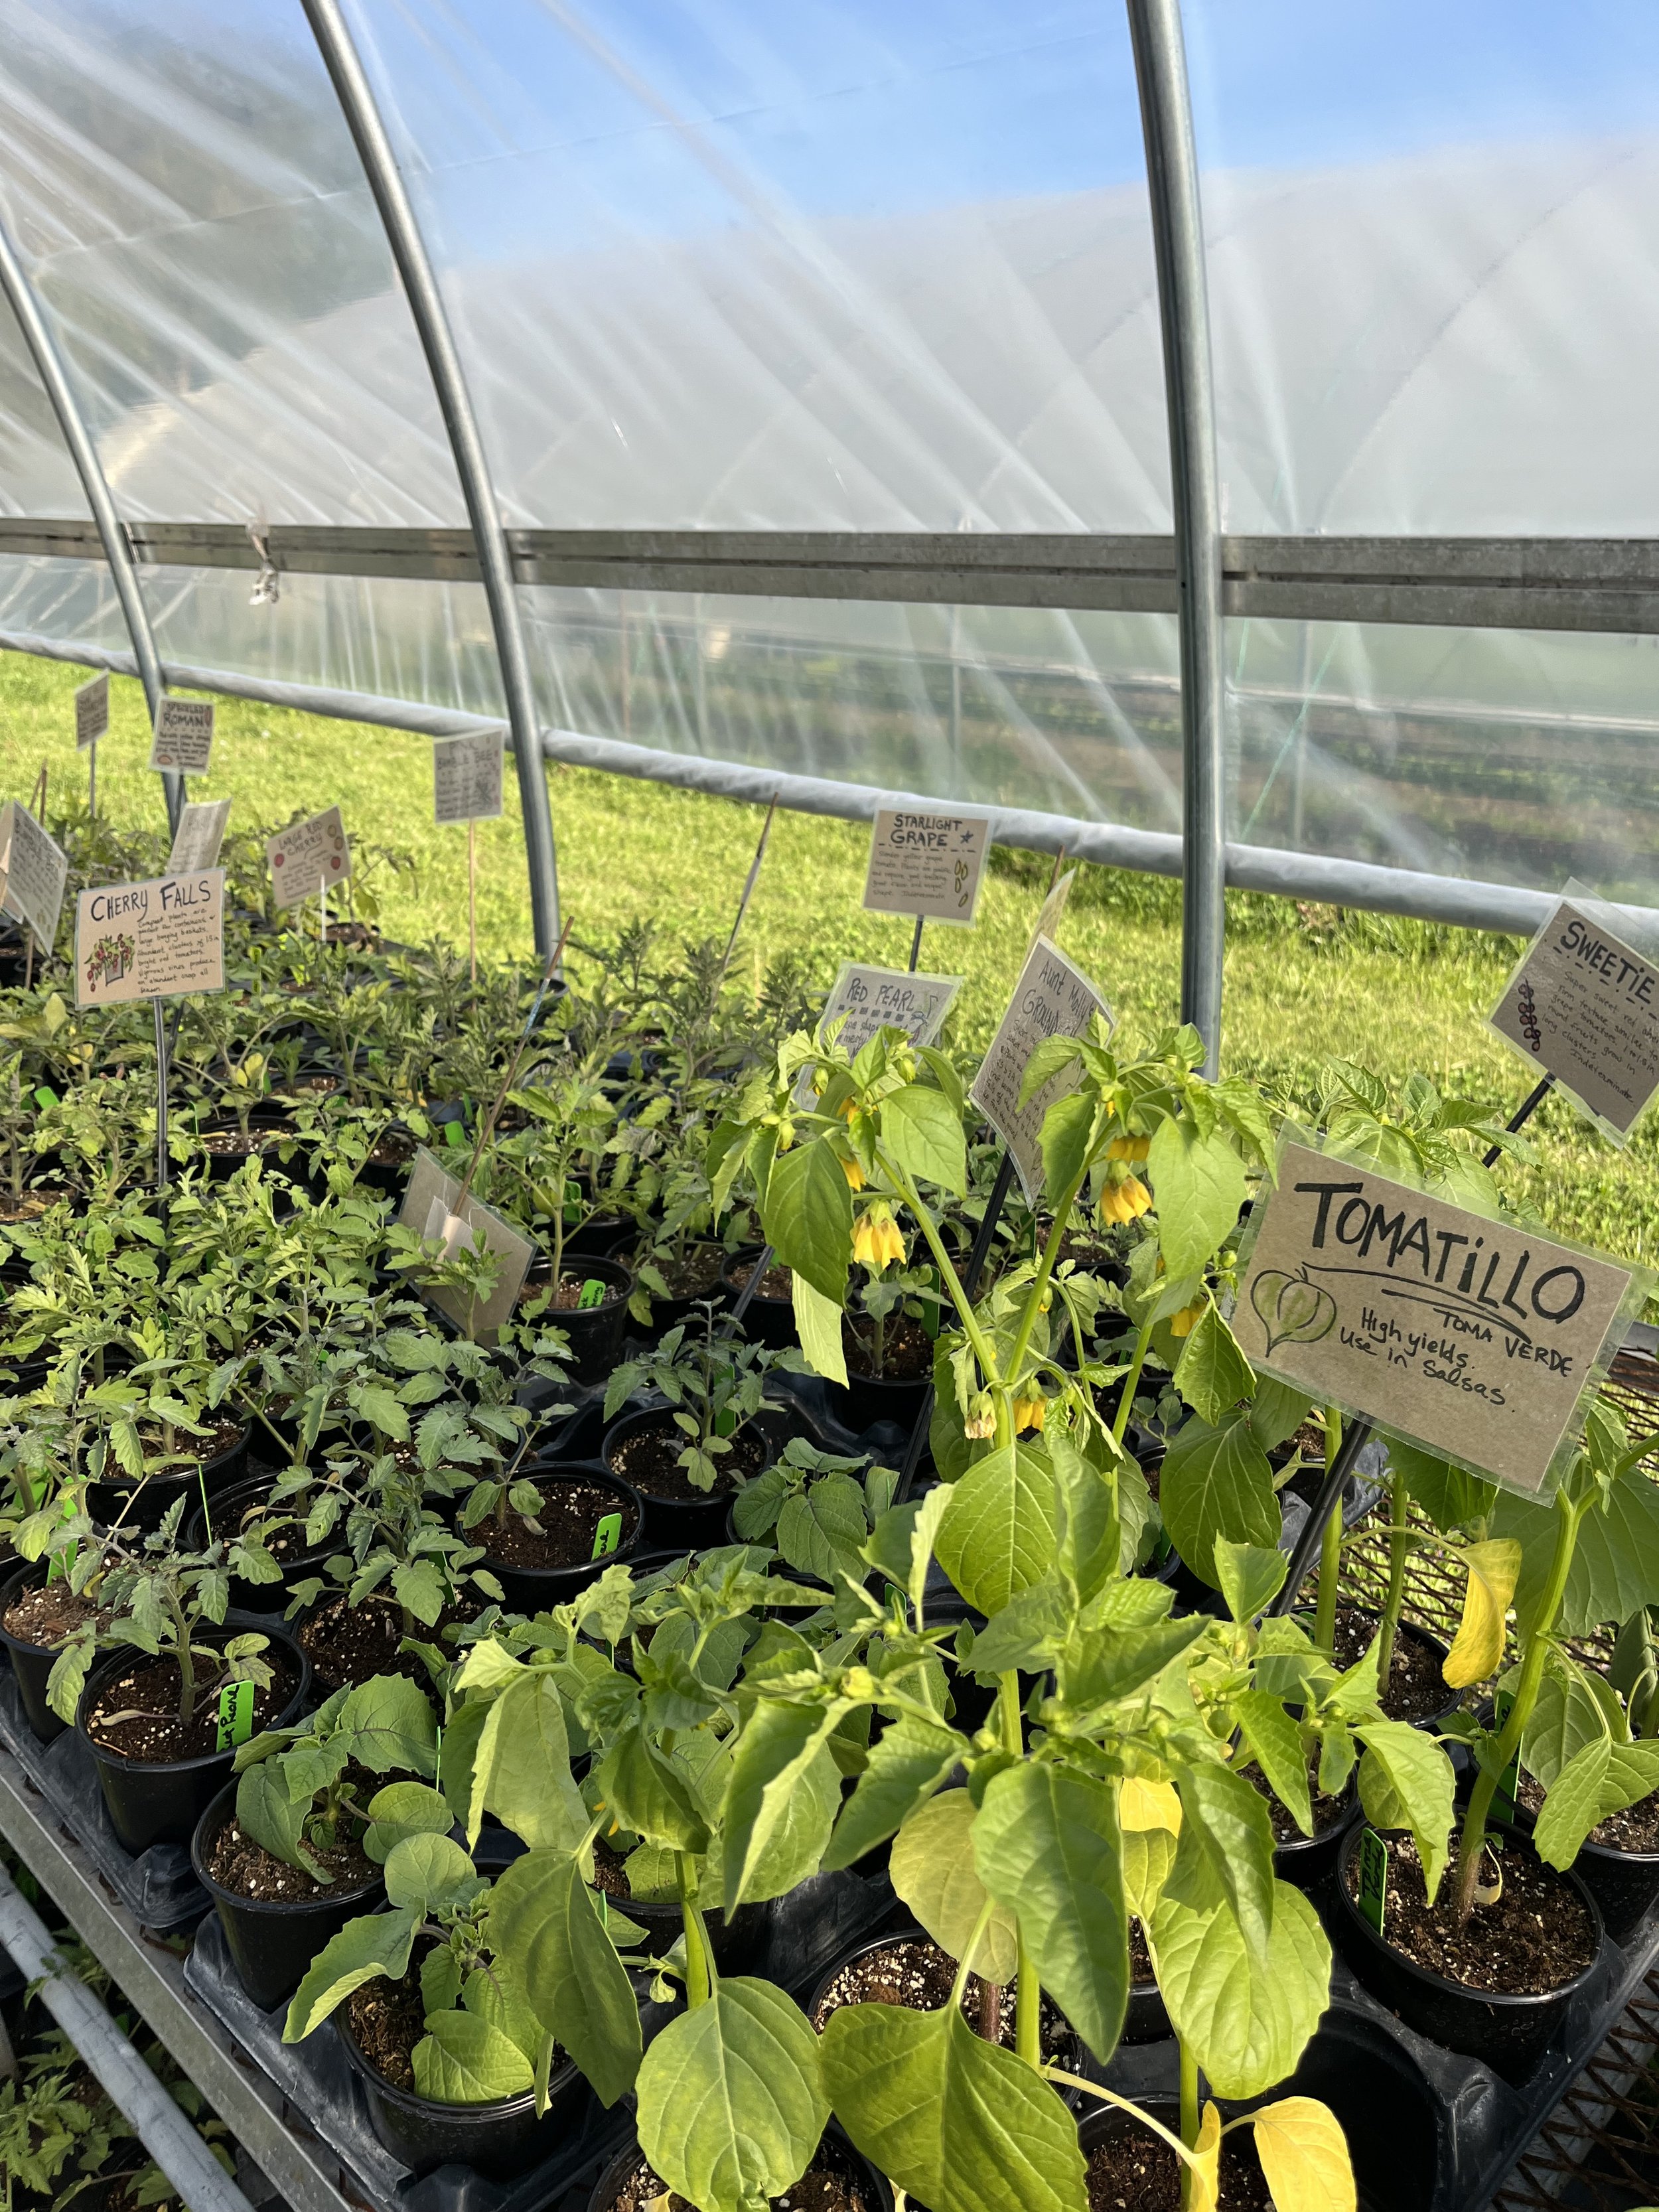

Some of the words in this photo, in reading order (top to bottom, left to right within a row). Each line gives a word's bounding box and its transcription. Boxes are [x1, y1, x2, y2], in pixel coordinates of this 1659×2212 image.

[163, 713, 204, 727] ROMAN
[891, 829, 948, 846] GRAPE
[894, 814, 963, 831] STARLIGHT
[91, 889, 148, 922] CHERRY
[159, 881, 211, 911] FALLS
[1039, 959, 1067, 995] Aunt
[847, 978, 868, 1002] RED
[875, 985, 914, 1011] PEARL
[1551, 994, 1573, 1012] grape
[1564, 971, 1588, 993] Super
[1624, 1015, 1638, 1027] red
[1542, 1014, 1558, 1034] long
[1562, 1030, 1597, 1059] clusters
[1601, 1047, 1623, 1063] grow
[1649, 1049, 1658, 1061] to
[1340, 1327, 1378, 1356] Use
[1388, 1347, 1407, 1368] in
[1433, 1307, 1493, 1342] TOMA
[1505, 1336, 1573, 1377] VERDE
